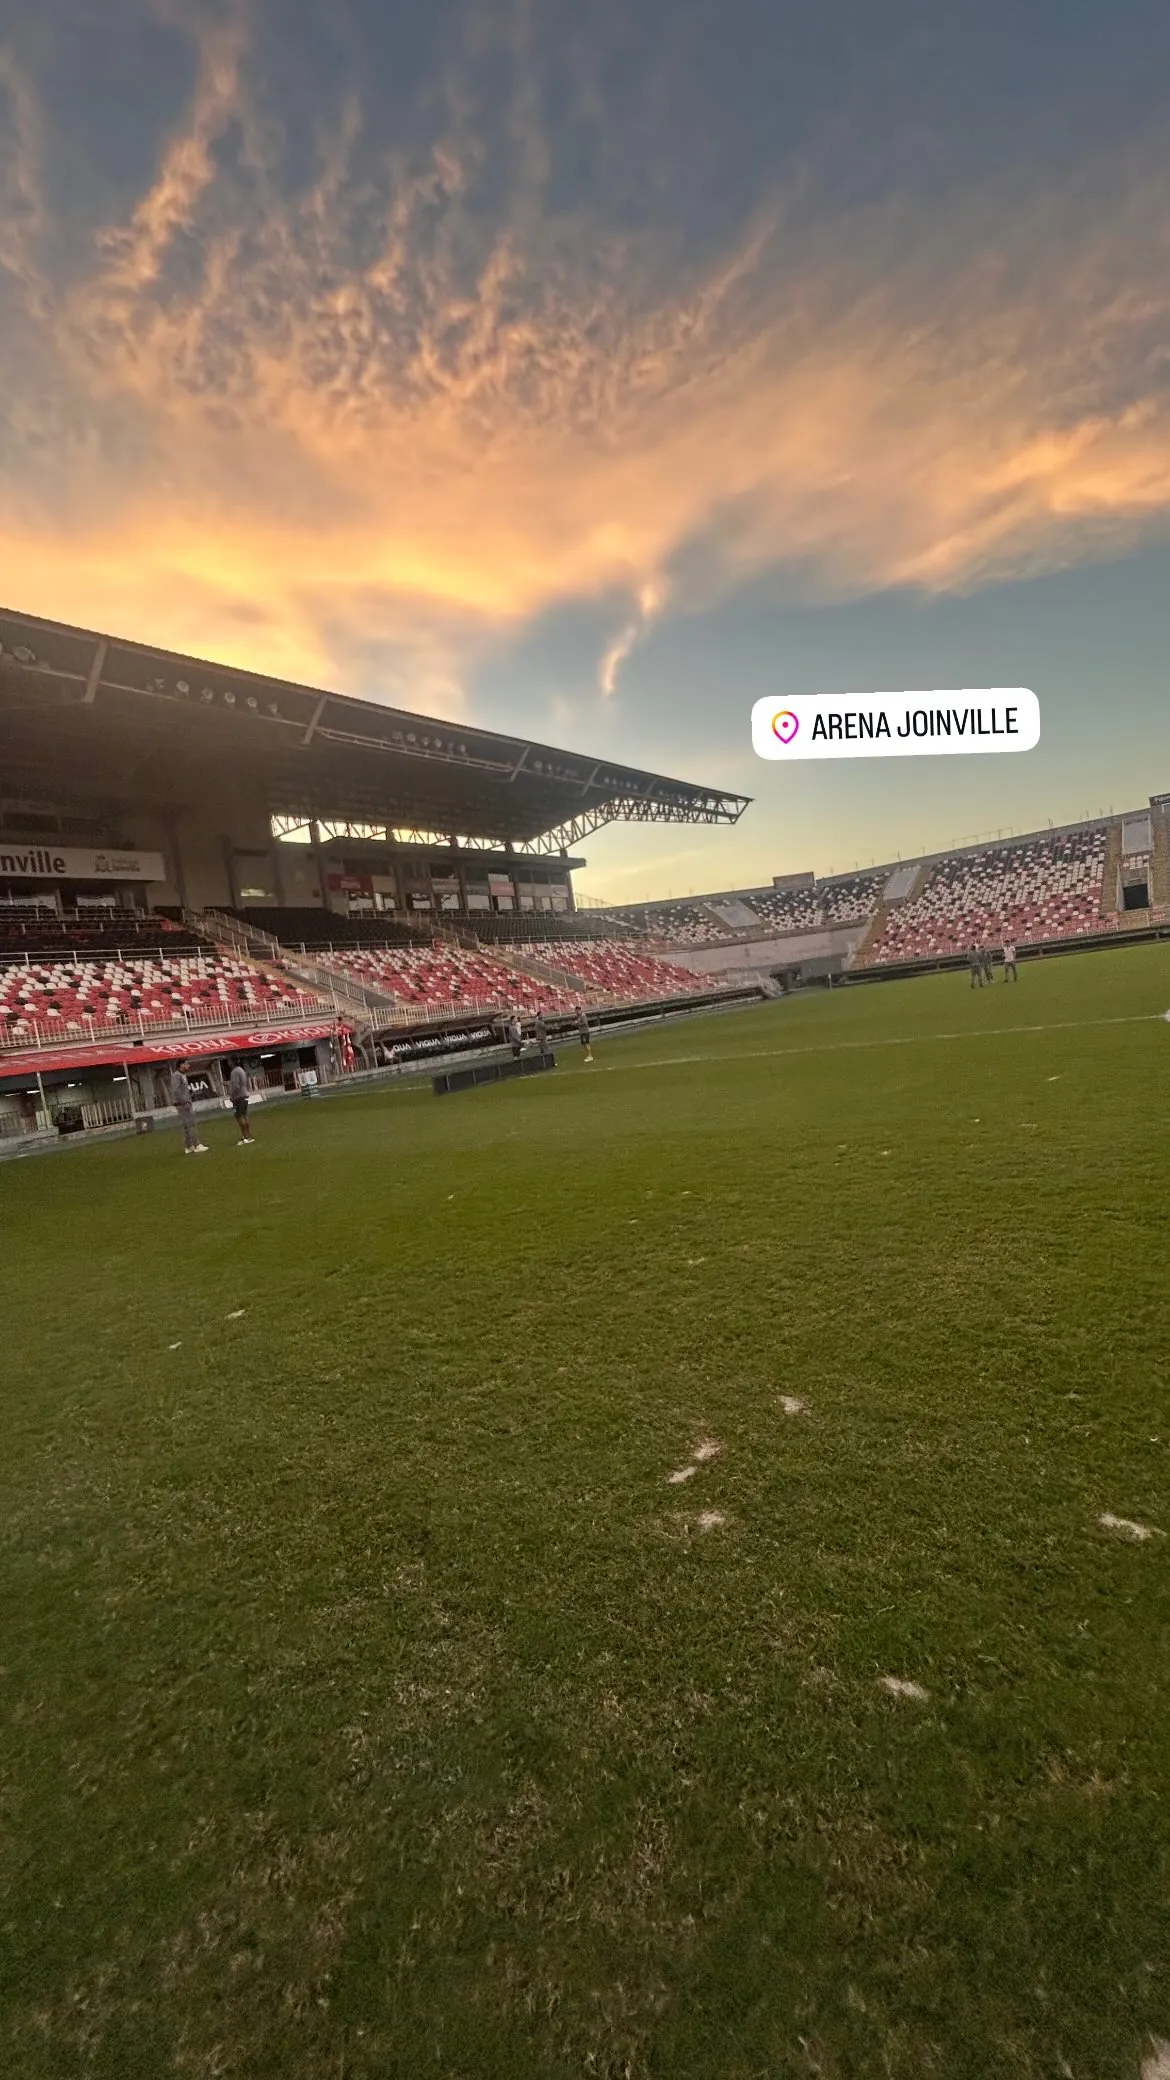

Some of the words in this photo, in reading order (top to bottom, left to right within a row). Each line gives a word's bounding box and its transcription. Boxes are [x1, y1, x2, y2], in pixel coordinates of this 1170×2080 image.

[0, 850, 66, 873] nville
[278, 1024, 334, 1040] KRON
[393, 1043, 411, 1052] QUA
[416, 1038, 440, 1048] VIQUA
[444, 1033, 467, 1043] VIQUA
[471, 1030, 491, 1039] VIQUA
[151, 1038, 235, 1055] KRONA
